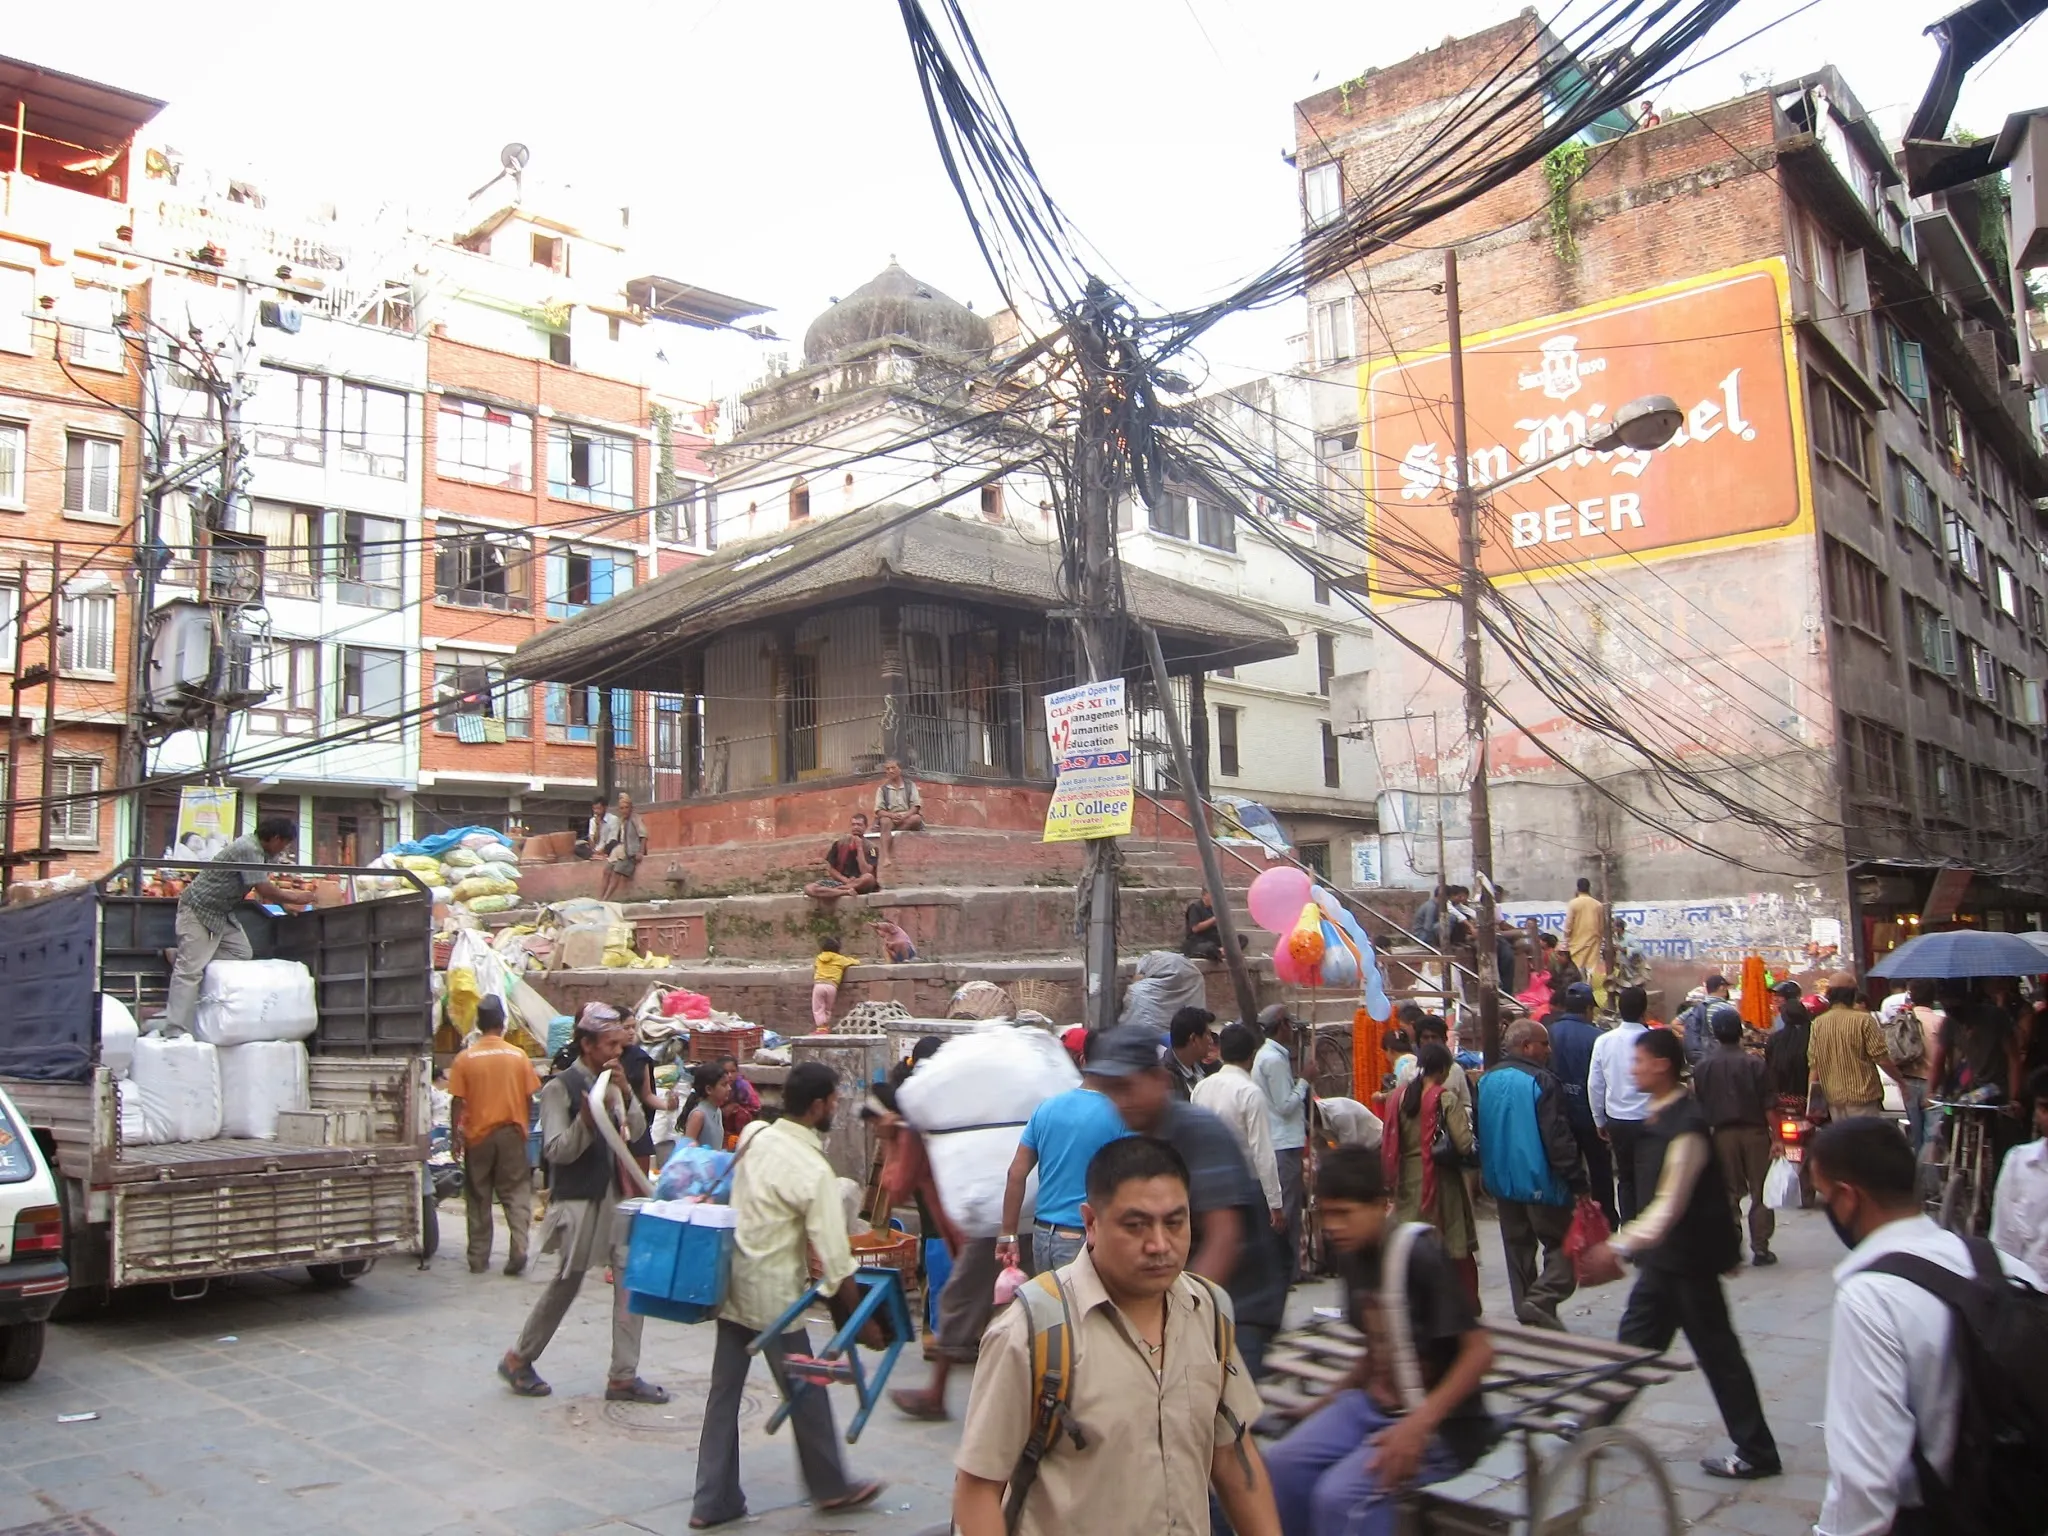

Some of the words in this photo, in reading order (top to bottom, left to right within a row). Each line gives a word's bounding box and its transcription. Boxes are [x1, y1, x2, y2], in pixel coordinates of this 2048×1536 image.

[1511, 492, 1645, 548] BEER
[1088, 687, 1108, 697] Open
[1109, 684, 1121, 693] for
[1088, 698, 1103, 709] XI
[1105, 697, 1117, 707] in
[1072, 723, 1119, 735] umanities
[1075, 800, 1128, 816] College
